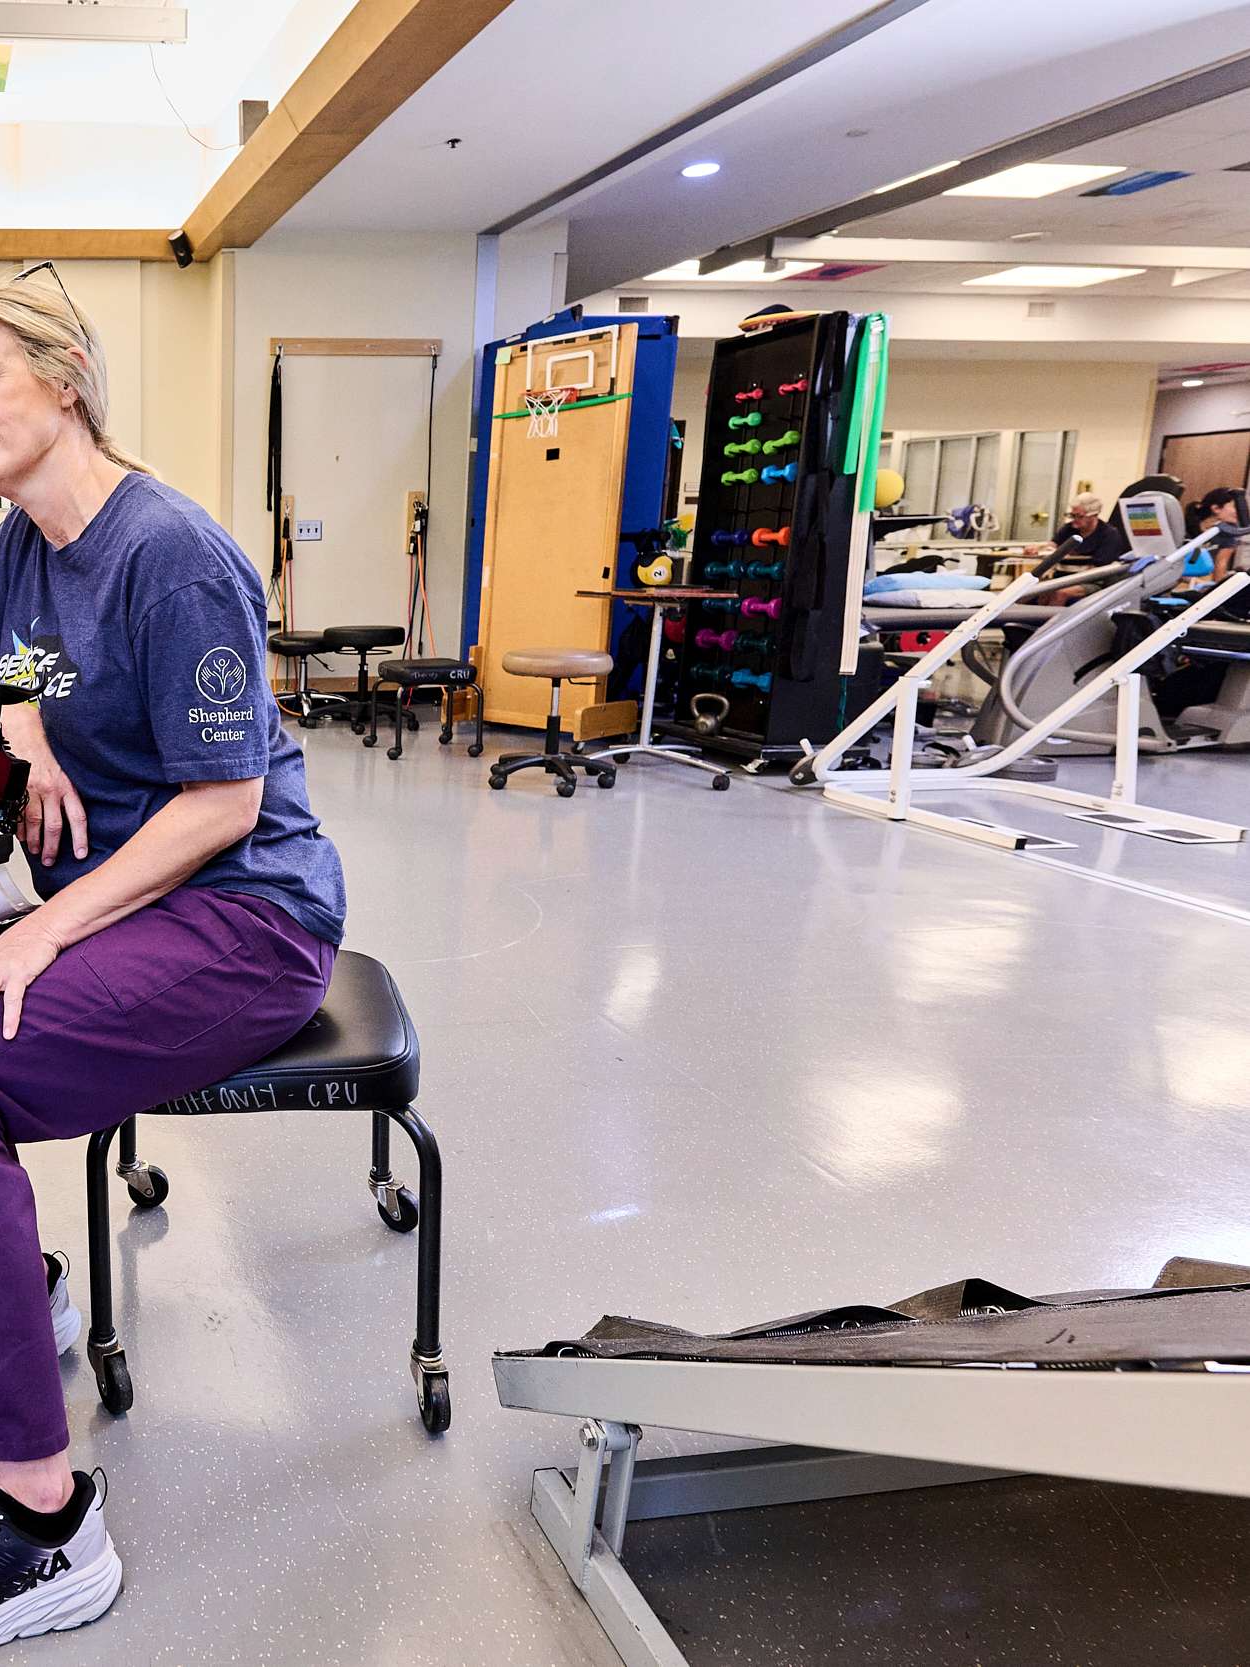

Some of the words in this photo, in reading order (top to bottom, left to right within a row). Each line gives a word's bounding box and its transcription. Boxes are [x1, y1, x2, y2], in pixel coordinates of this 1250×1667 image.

[449, 669, 470, 679] CRU
[188, 706, 254, 725] Shepherd
[201, 727, 245, 743] Center
[219, 1083, 277, 1110] ONLY
[308, 1081, 357, 1107] CRU
